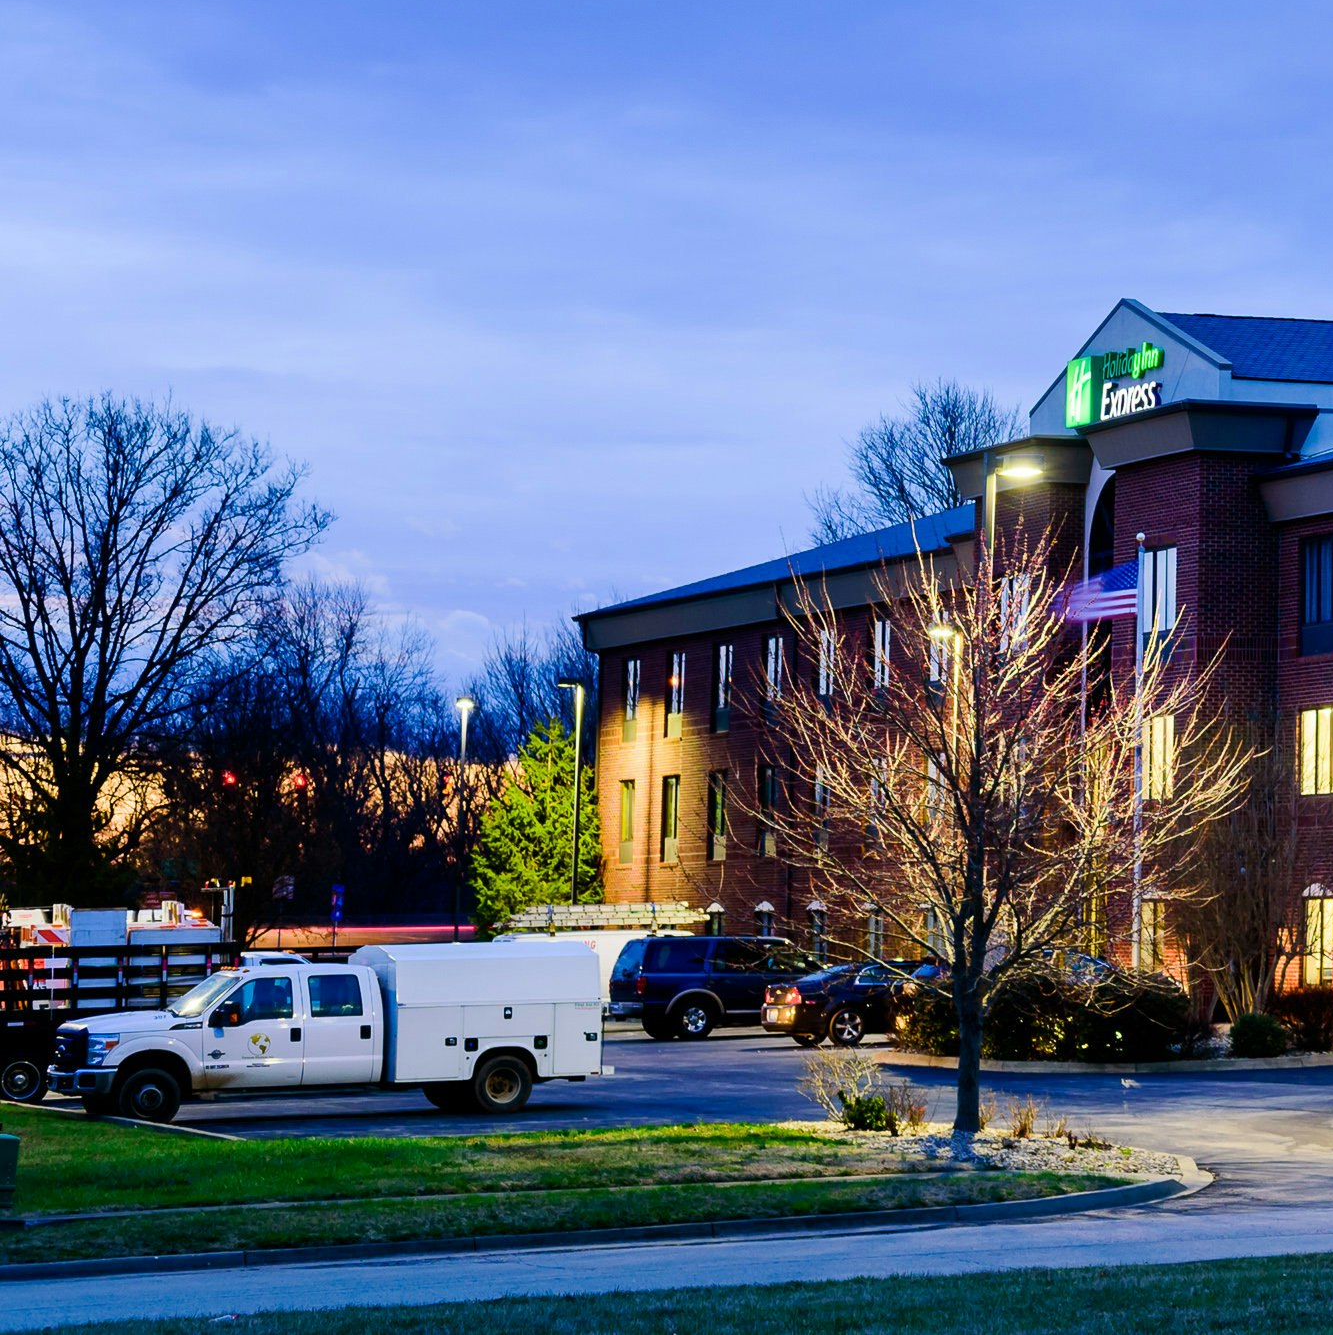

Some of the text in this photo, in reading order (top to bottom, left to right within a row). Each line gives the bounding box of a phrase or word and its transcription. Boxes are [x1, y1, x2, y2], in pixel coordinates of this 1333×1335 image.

[1102, 341, 1160, 379] Holiday Inn
[1100, 380, 1157, 421] Express
